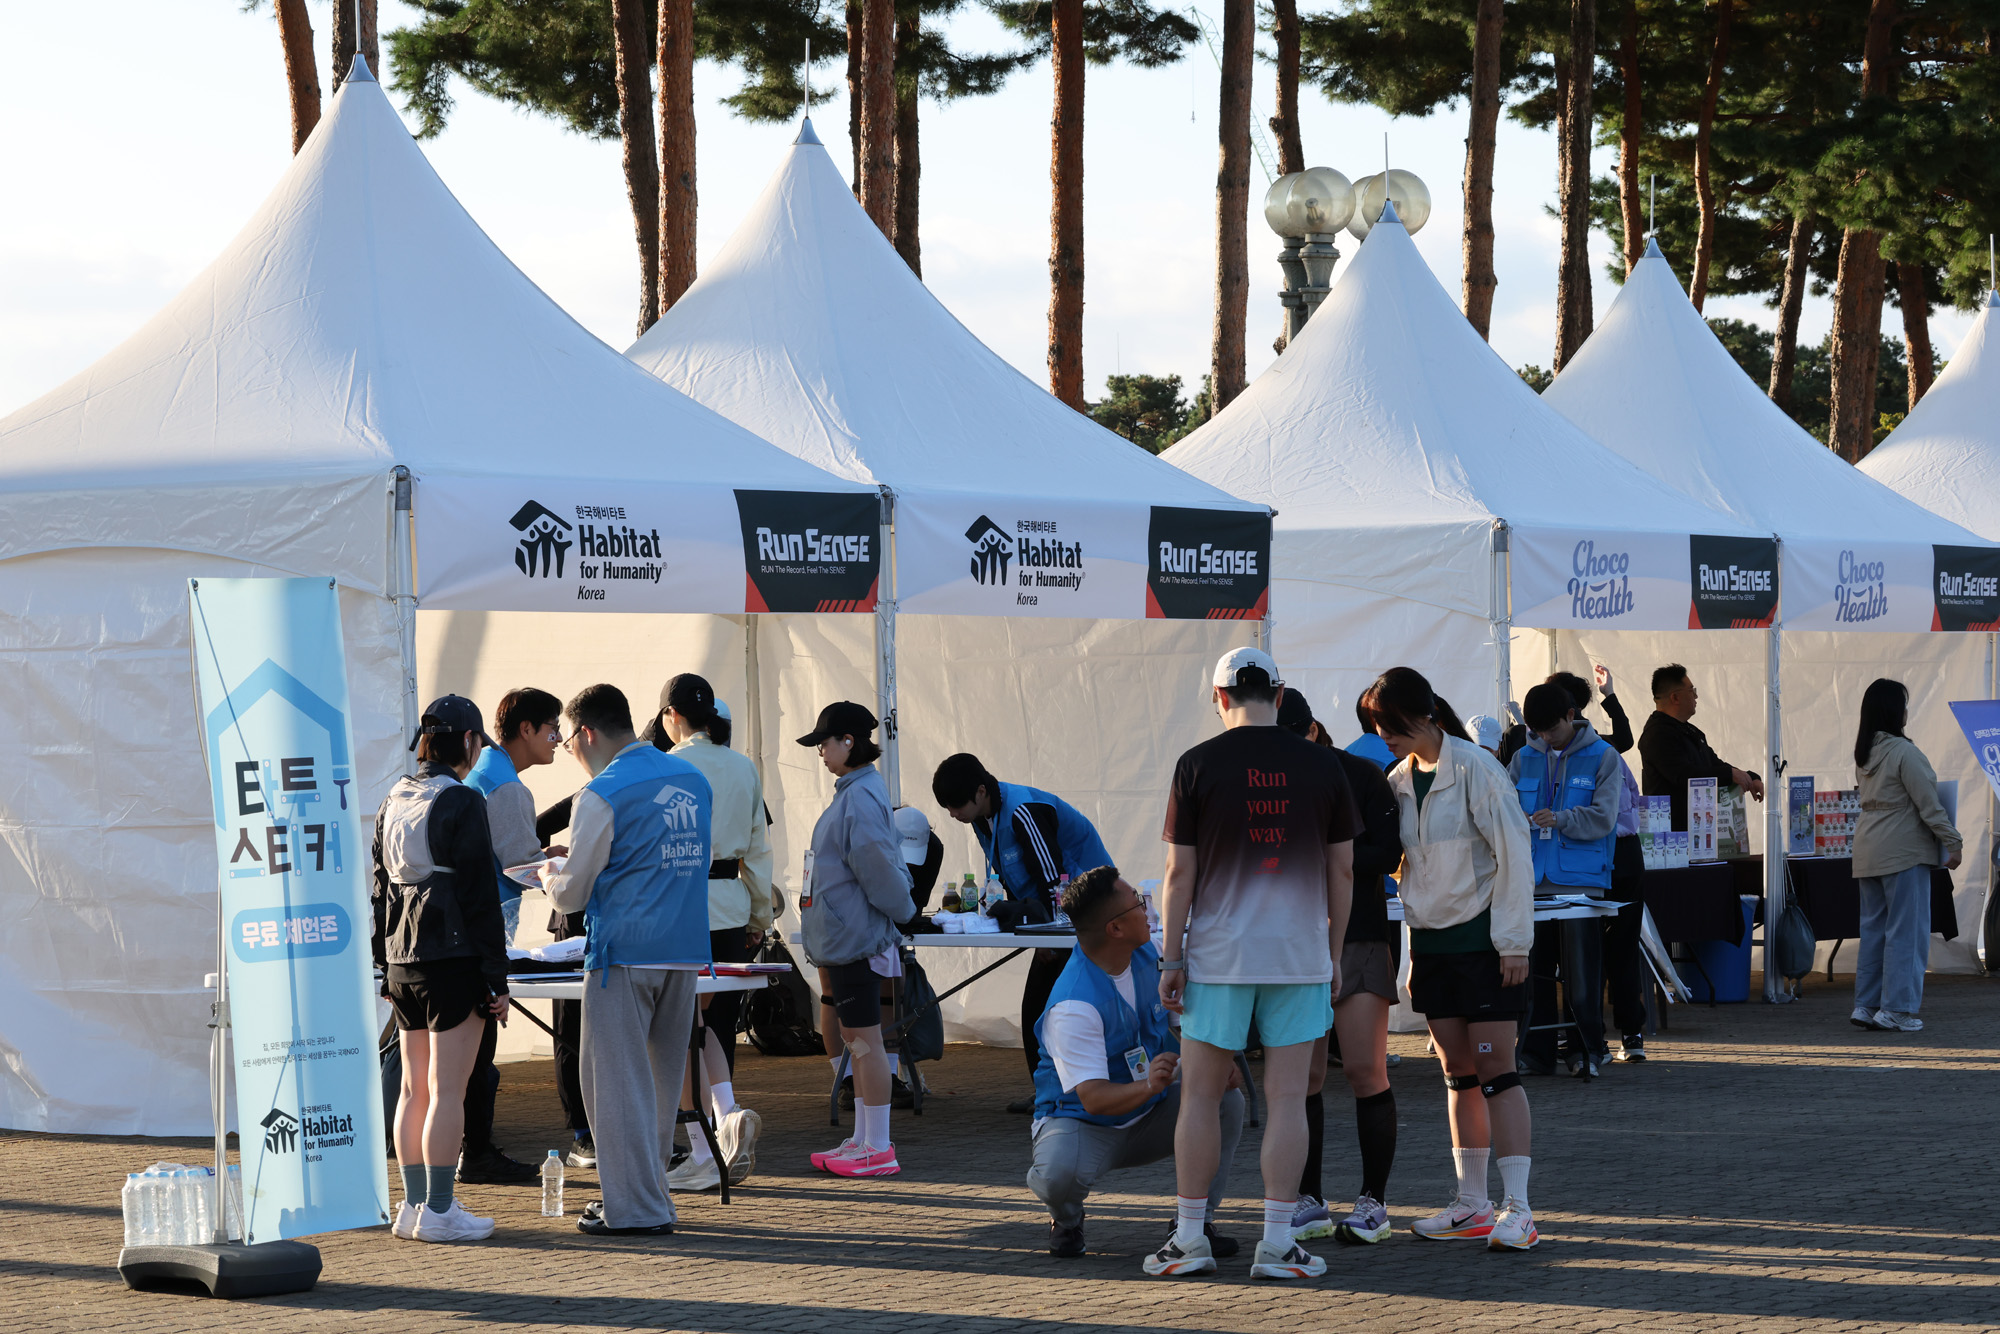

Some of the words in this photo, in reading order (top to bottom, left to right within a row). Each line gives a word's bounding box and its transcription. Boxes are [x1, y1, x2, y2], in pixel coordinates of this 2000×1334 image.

[575, 505, 627, 520] 한국해비타트
[1016, 519, 1057, 534] 한국해비타트
[578, 524, 662, 558] Habitat
[1017, 537, 1083, 569] Habitat
[1572, 539, 1630, 578] Choco
[580, 560, 599, 579] for
[761, 565, 775, 574] RUN
[775, 565, 785, 574] The
[807, 566, 818, 574] Feel
[819, 566, 829, 574] The
[829, 566, 846, 575] SENSE
[1838, 549, 1885, 585] Choco
[1019, 570, 1033, 587] for
[1171, 576, 1181, 585] The
[1199, 577, 1210, 585] Feel
[1210, 577, 1218, 585] The
[577, 585, 605, 600] Korea
[1016, 591, 1038, 606] Korea
[1567, 574, 1635, 620] Health
[1834, 581, 1889, 623] Health
[234, 756, 321, 818] 타투
[1246, 768, 1288, 788] Run
[1245, 799, 1290, 821] your
[1248, 827, 1287, 849] way.
[229, 821, 344, 879] 스티커
[661, 841, 704, 860] Habitat
[661, 861, 671, 870] for
[241, 919, 281, 950] 무료
[283, 914, 339, 946] 체험존
[270, 1042, 281, 1051] 모든
[242, 1059, 252, 1068] 모든
[301, 1114, 354, 1138] Habitat
[304, 1139, 316, 1151] for
[305, 1153, 323, 1164] Korea
